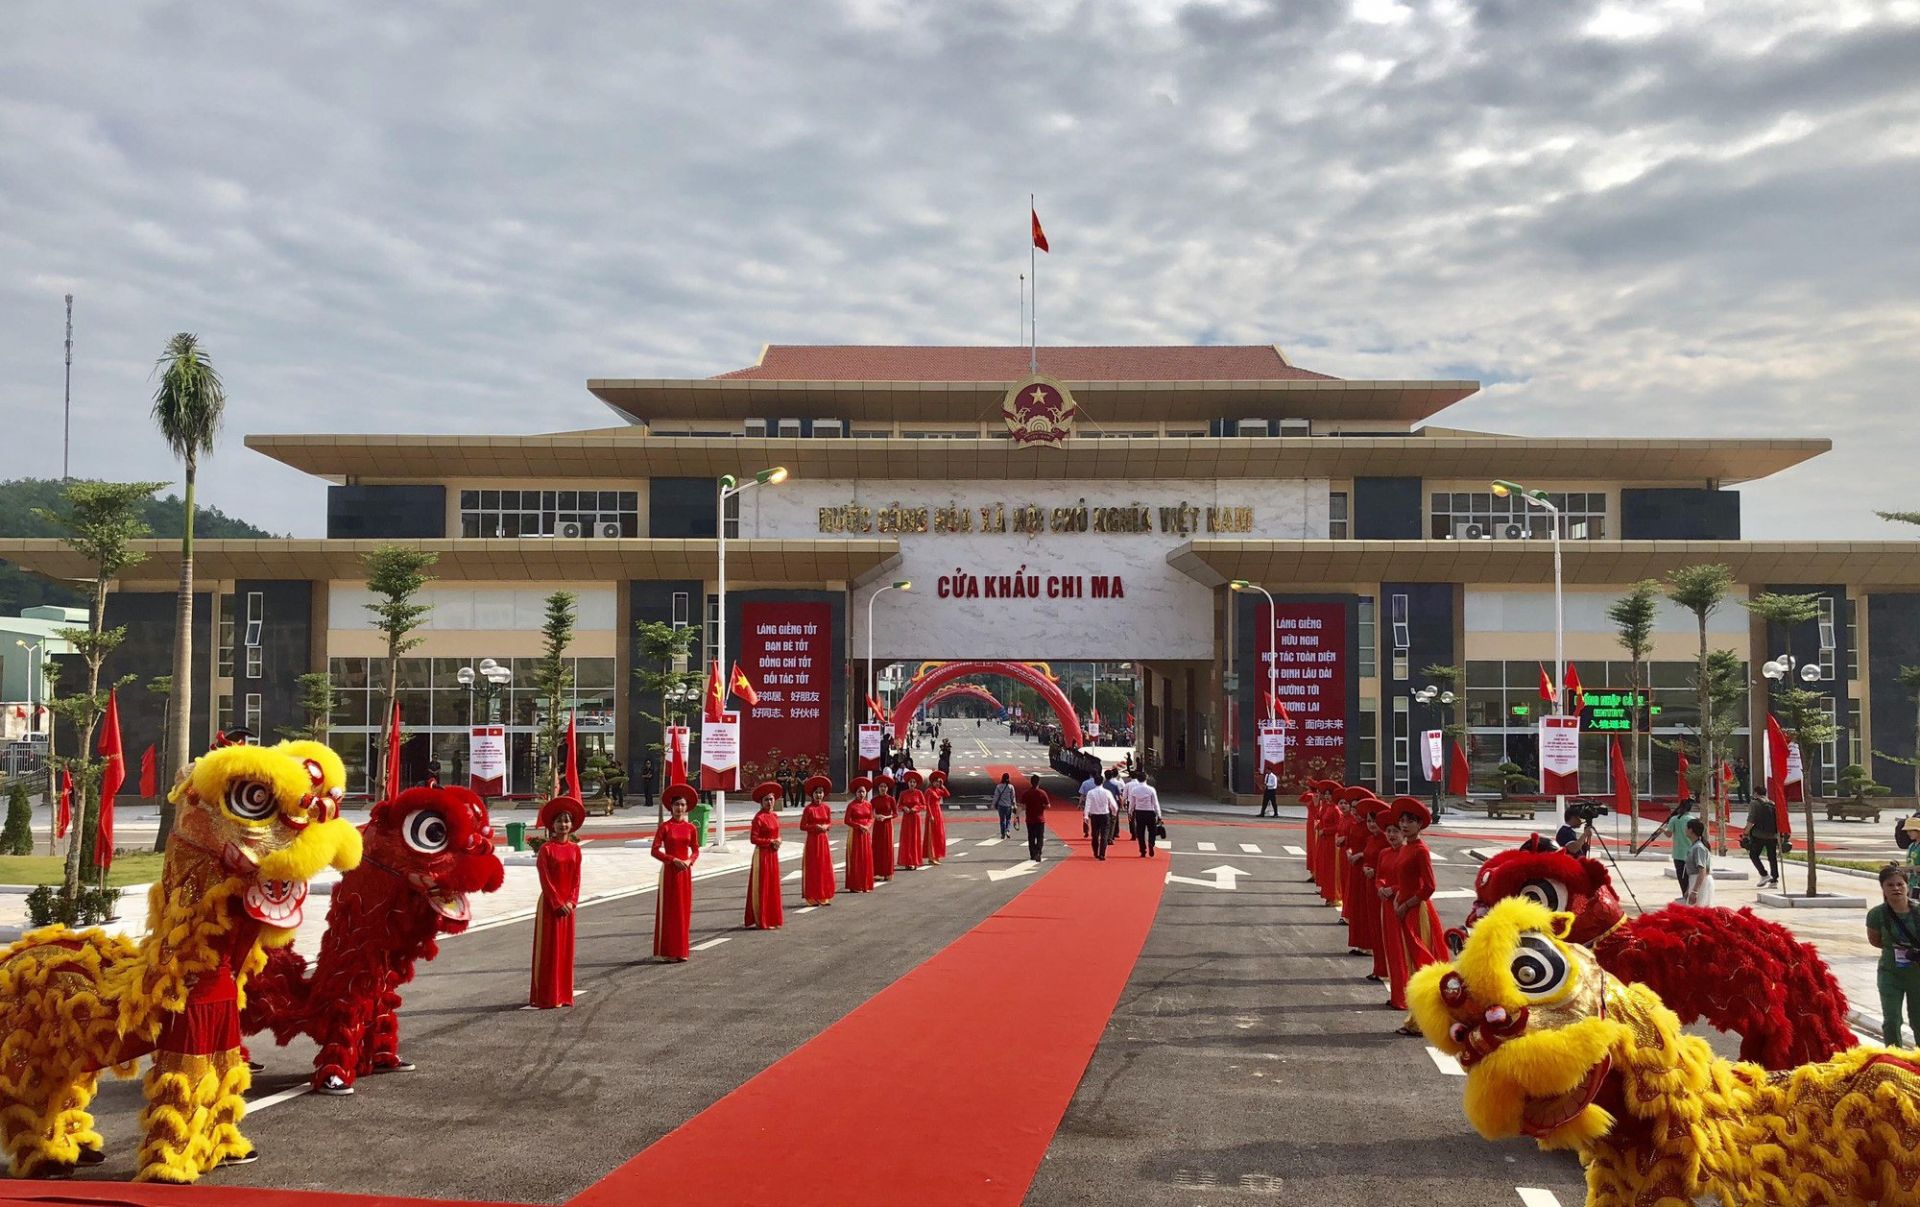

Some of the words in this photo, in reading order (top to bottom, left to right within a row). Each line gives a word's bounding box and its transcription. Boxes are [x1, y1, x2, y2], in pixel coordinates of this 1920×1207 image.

[1158, 501, 1200, 538] VIỆT
[1206, 507, 1254, 533] NAM
[937, 567, 980, 599] CỬA
[984, 564, 1040, 599] KHẨU
[1046, 575, 1083, 599] CHI
[1091, 575, 1125, 599] MA
[803, 621, 818, 635] TỐT
[765, 640, 781, 653] BẠN
[795, 638, 809, 651] TỐT
[782, 655, 797, 668] CHÍ
[798, 654, 812, 668] TỐT
[1280, 650, 1294, 662] TÁC
[763, 670, 778, 684] ĐỐI
[779, 672, 794, 684] TÁC
[795, 670, 810, 684] TỐT
[1307, 702, 1320, 712] LAI
